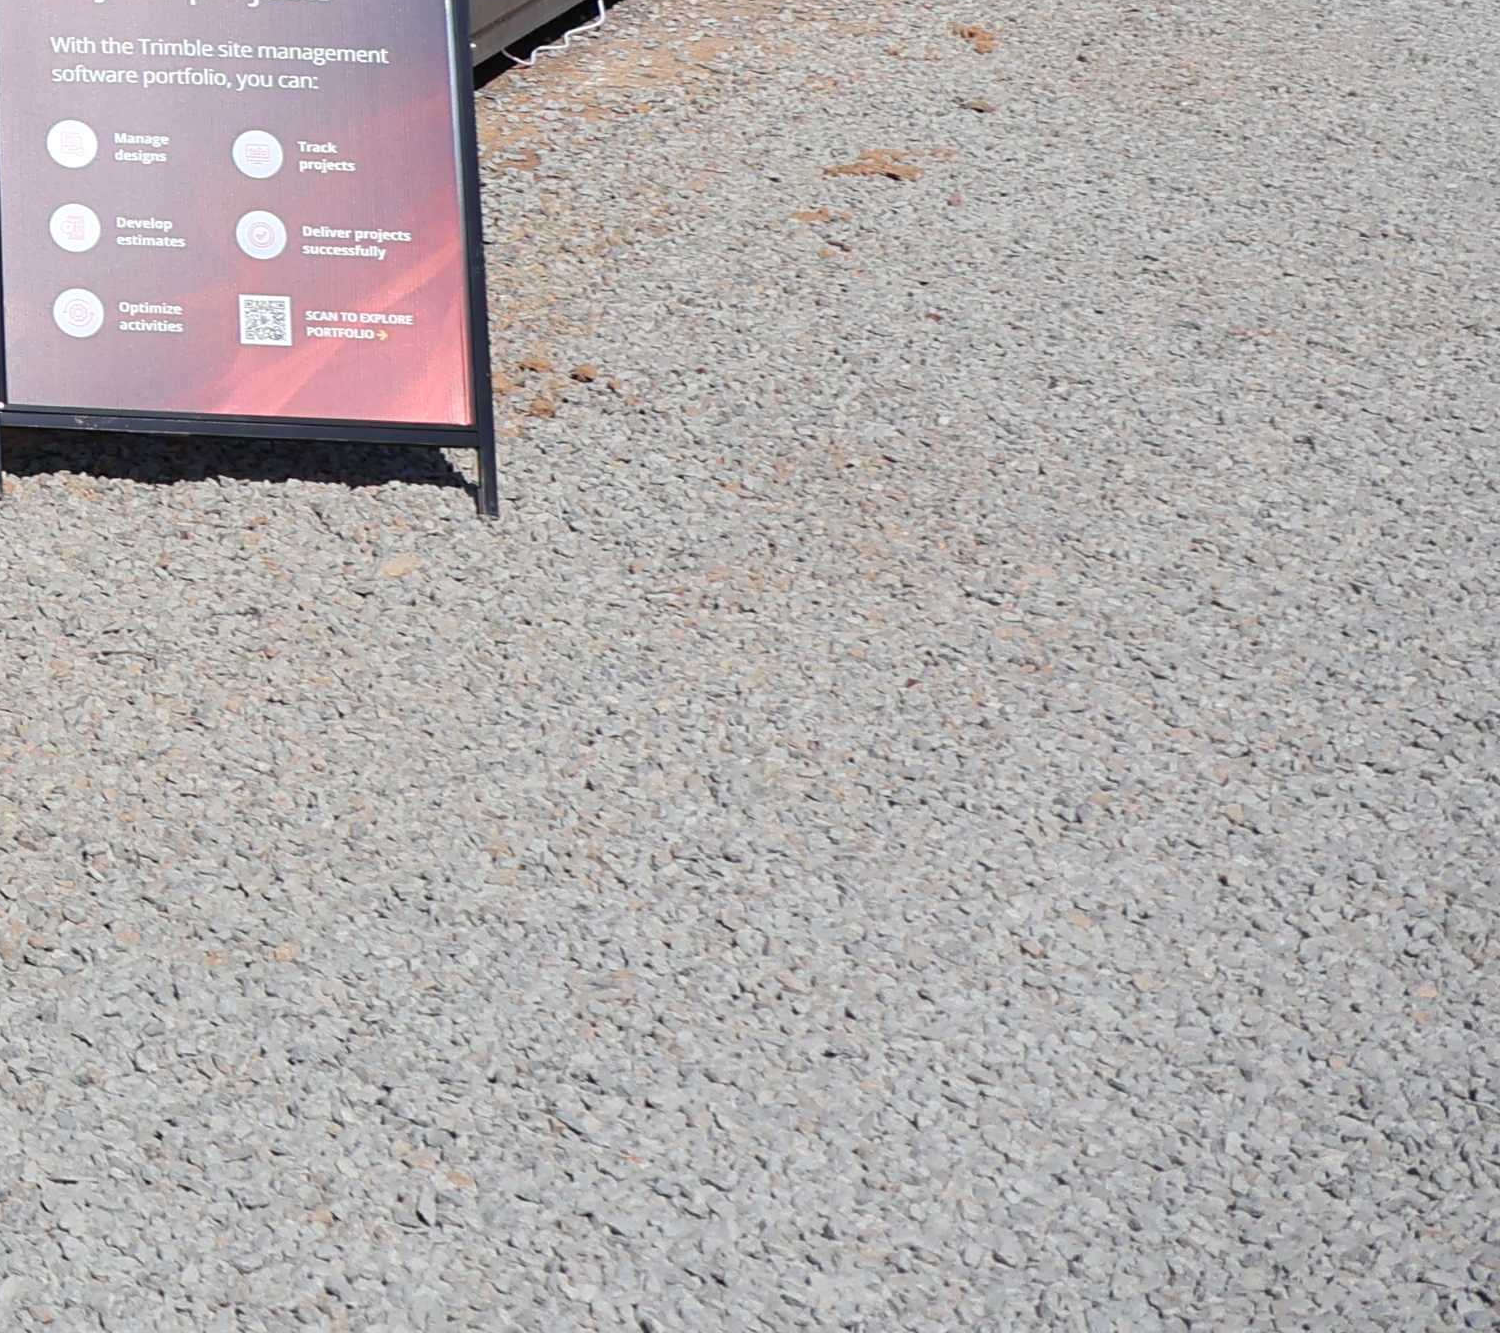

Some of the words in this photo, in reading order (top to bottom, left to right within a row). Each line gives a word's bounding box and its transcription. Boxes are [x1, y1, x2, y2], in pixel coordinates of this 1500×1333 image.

[50, 36, 97, 54] With
[99, 37, 134, 55] the
[136, 38, 214, 58] Trimble
[217, 40, 253, 59] site
[257, 43, 390, 66] management
[51, 64, 138, 84] software
[142, 66, 233, 89] portfolio,
[235, 73, 274, 91] you
[277, 71, 320, 90] can:
[114, 132, 170, 149] Manage
[297, 140, 338, 154] Track
[114, 148, 168, 165] designs
[298, 158, 357, 174] projects
[116, 216, 173, 233] Develop
[116, 234, 186, 248] estimates
[301, 225, 352, 241] Deliver
[354, 227, 413, 243] projects
[301, 244, 387, 261] successfully
[118, 301, 183, 319] Optimize
[304, 309, 339, 323] SCAN
[340, 311, 358, 324] TO
[359, 312, 414, 325] EXPLORE
[119, 318, 184, 334] activities
[306, 326, 375, 340] PORTFOLIO
